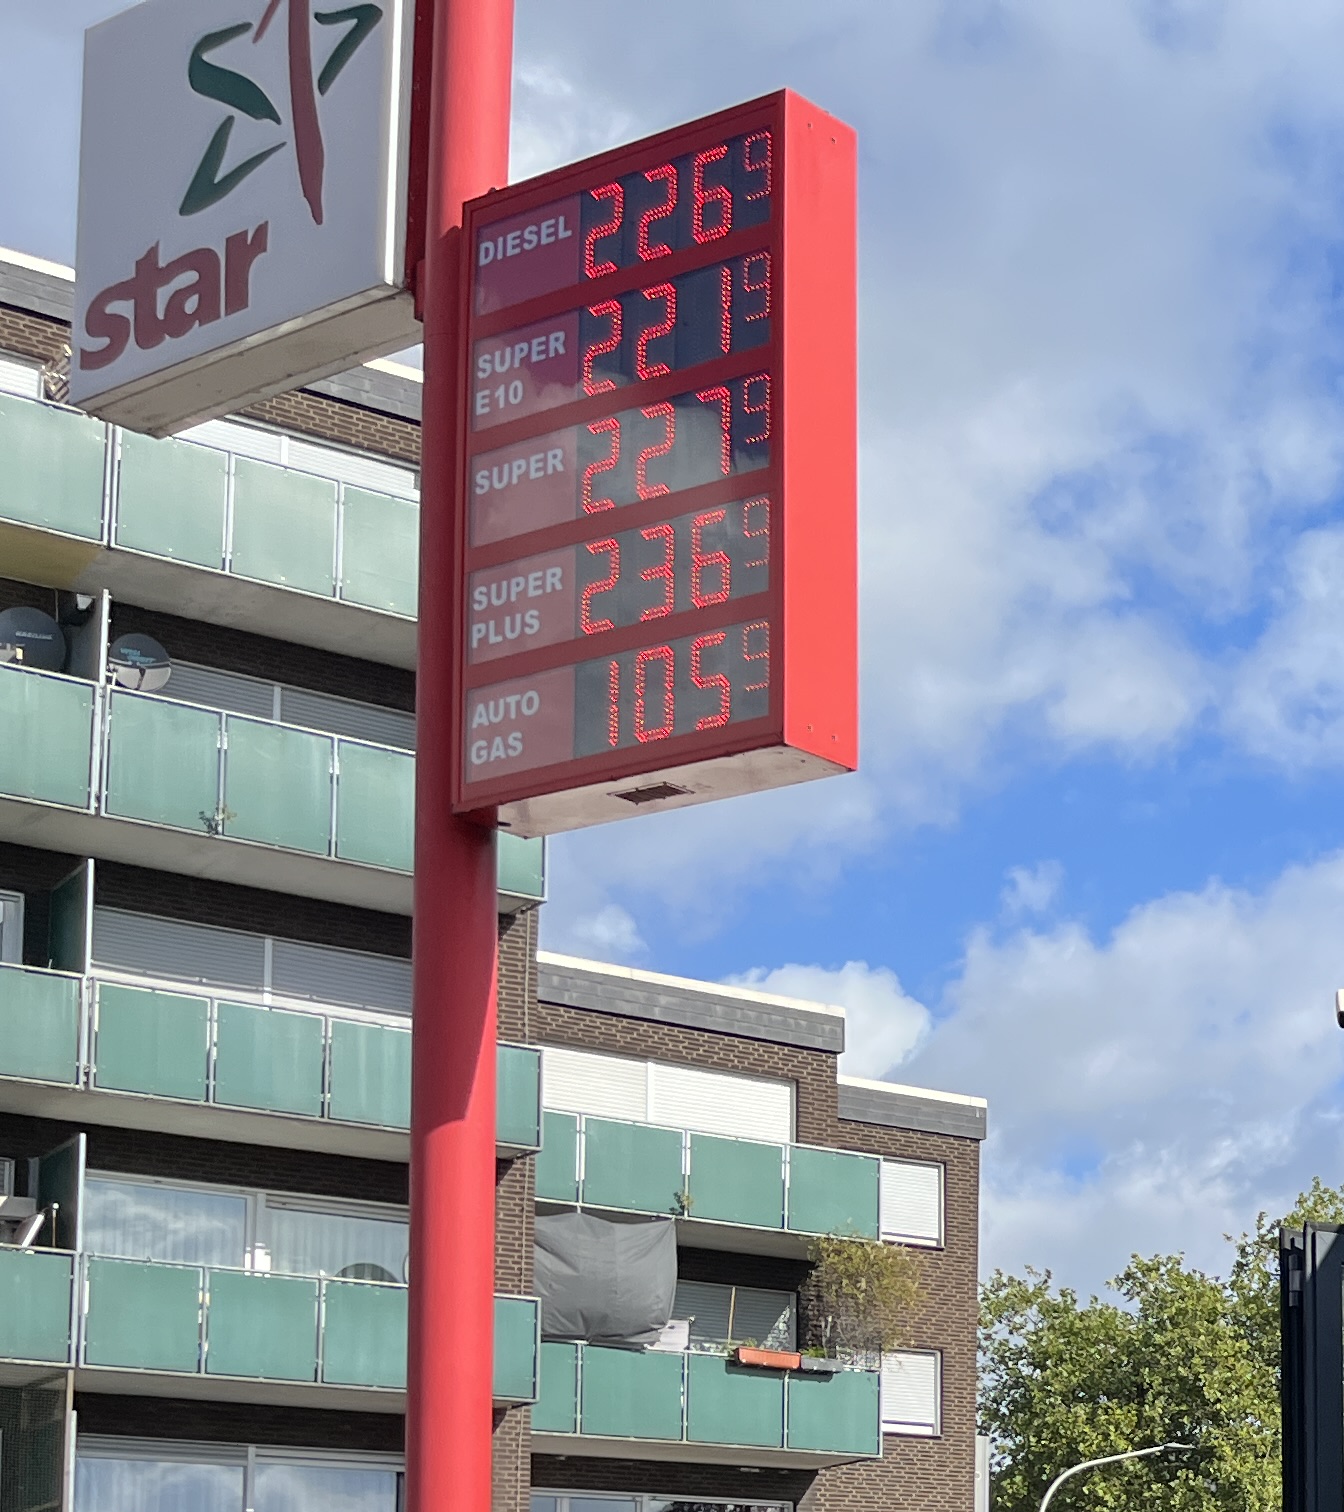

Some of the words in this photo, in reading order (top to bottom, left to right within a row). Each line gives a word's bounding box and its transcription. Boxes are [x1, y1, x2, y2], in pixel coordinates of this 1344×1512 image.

[478, 215, 572, 267] DIESEL
[79, 220, 269, 371] star
[476, 331, 567, 379] SUPER
[474, 379, 524, 417] E10
[474, 447, 565, 496] SUPER
[472, 566, 564, 612] SUPER
[470, 609, 541, 649] PLUS
[470, 690, 541, 729] AUTO
[470, 731, 524, 766] GAS
